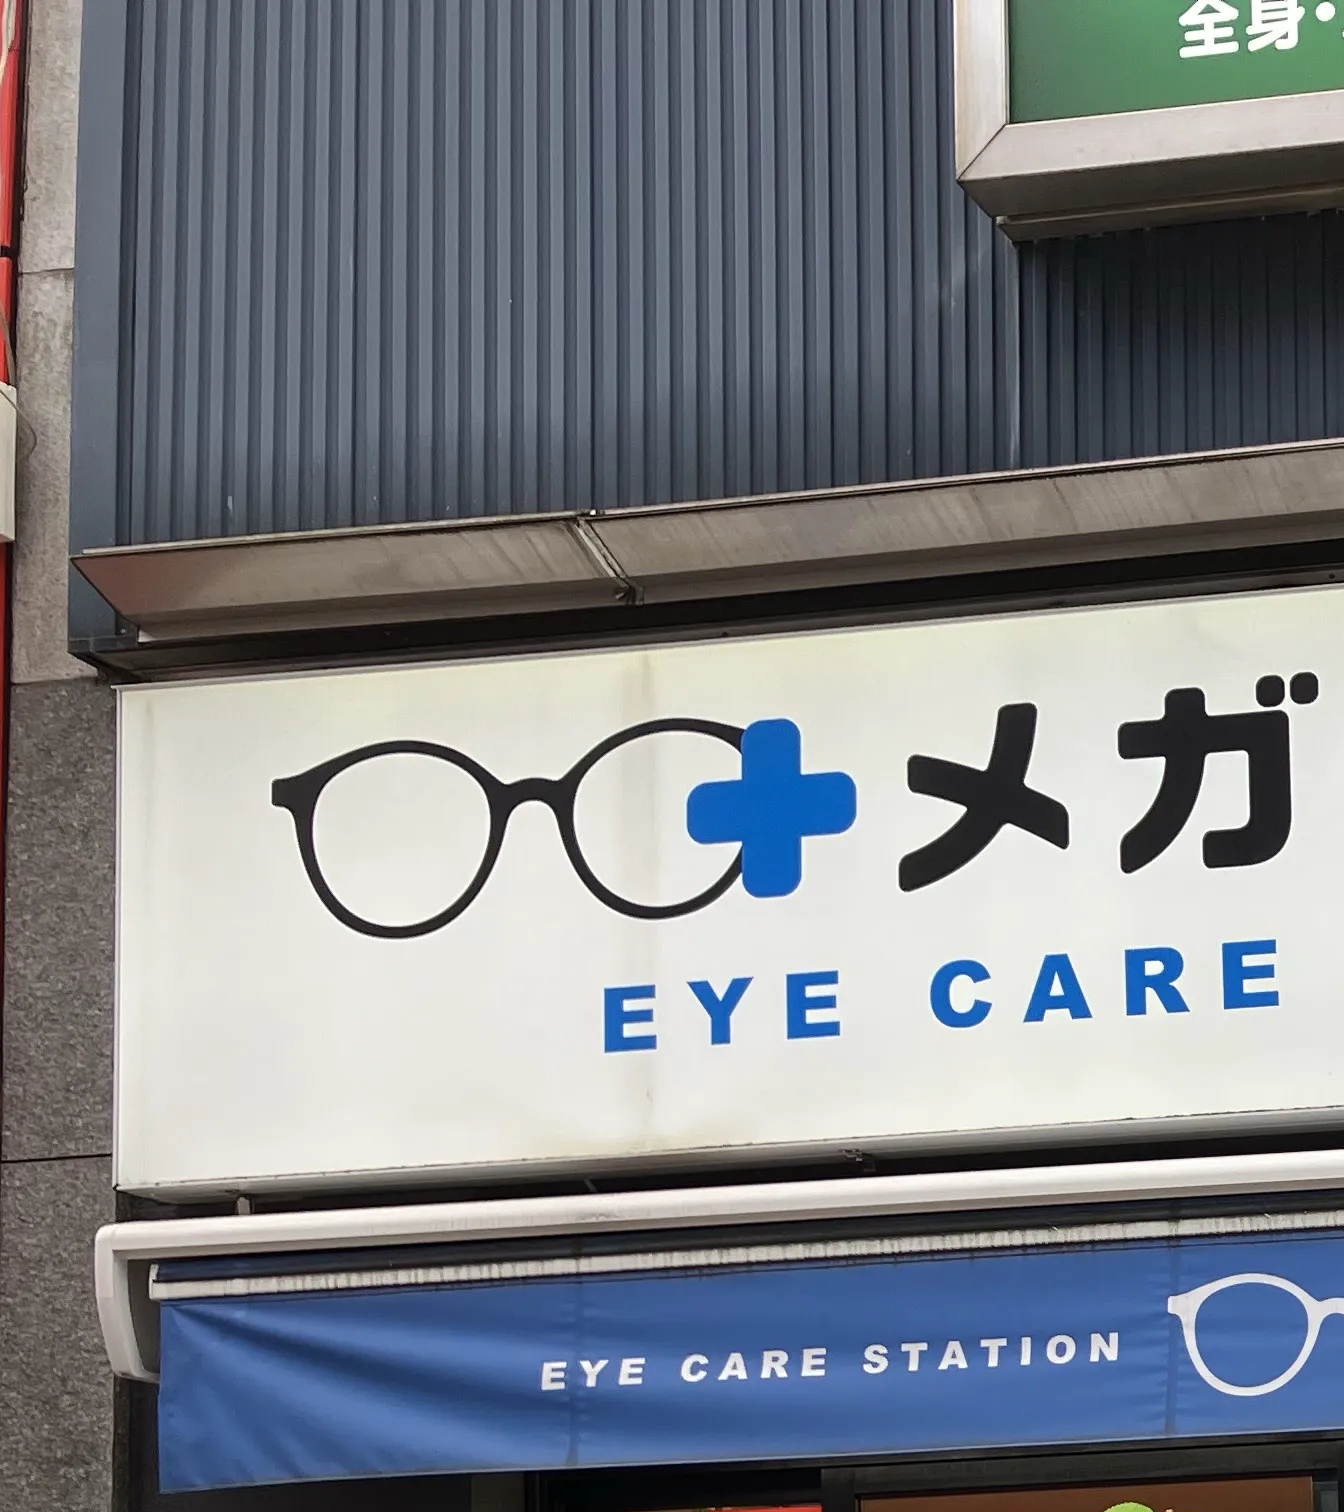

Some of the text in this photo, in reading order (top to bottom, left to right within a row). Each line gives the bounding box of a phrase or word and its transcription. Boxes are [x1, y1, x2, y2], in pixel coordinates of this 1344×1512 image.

[603, 969, 842, 1055] EYE
[928, 940, 1278, 1030] CARE
[540, 1331, 1121, 1391] EYE CARE STATION
